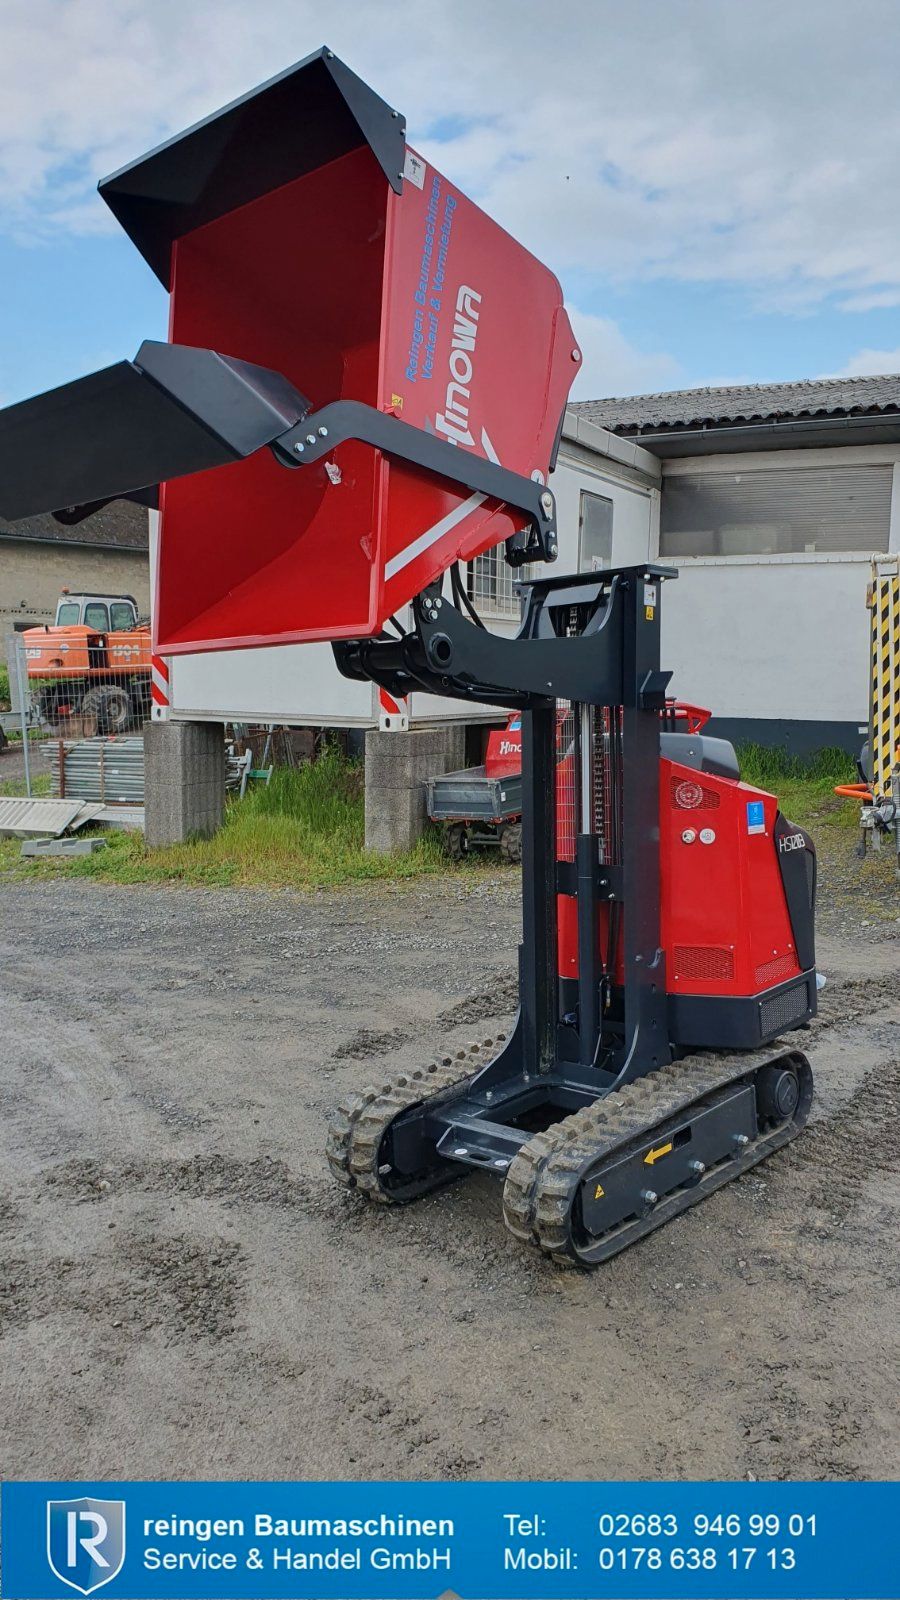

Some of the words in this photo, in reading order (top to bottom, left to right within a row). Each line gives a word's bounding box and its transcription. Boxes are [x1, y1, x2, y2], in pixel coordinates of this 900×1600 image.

[405, 309, 424, 382] Reingen
[415, 176, 440, 306] Baumaschinen
[432, 194, 457, 290] Vermietung
[430, 298, 441, 311] &
[421, 312, 439, 379] Verkauf
